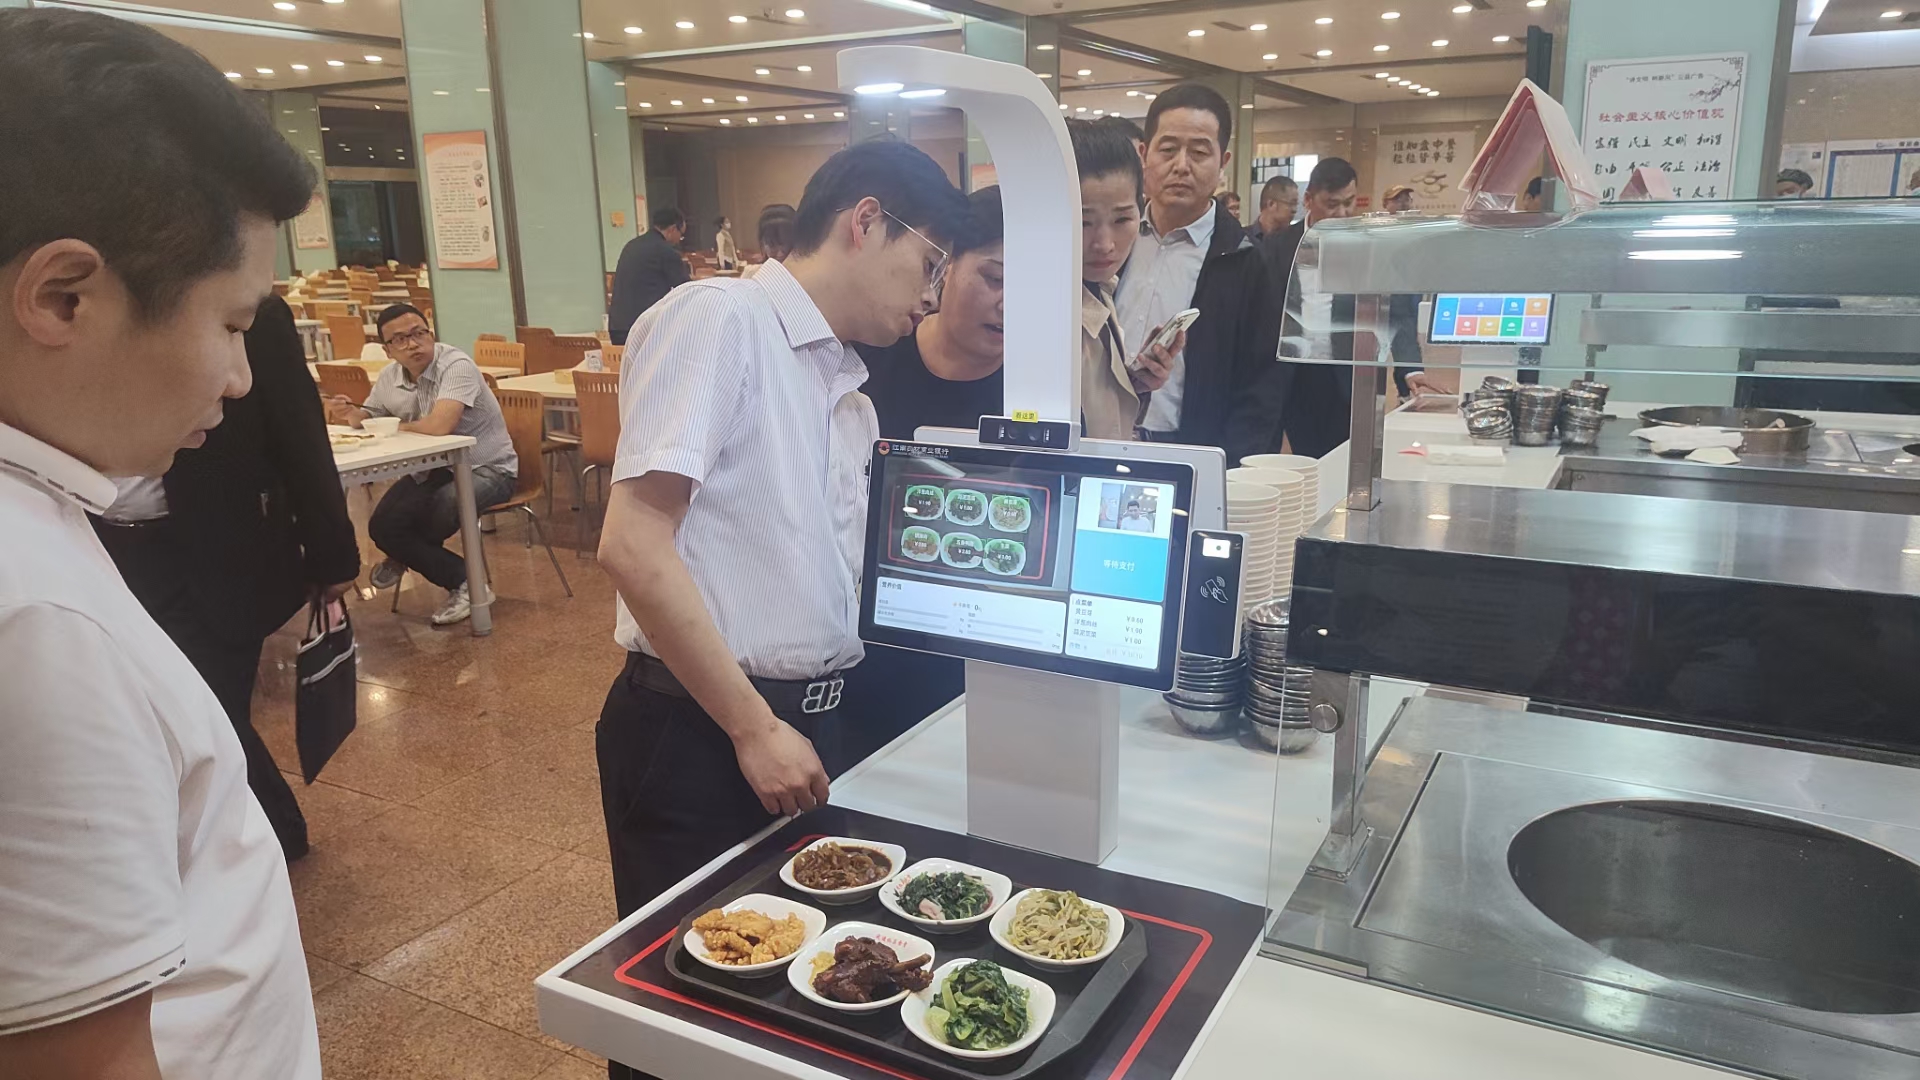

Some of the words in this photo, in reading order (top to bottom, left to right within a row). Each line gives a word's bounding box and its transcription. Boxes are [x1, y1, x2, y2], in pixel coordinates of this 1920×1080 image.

[1598, 107, 1725, 123] 社会主义核心价值观
[1628, 135, 1651, 148] 民主
[1662, 133, 1687, 147] 文明
[1696, 132, 1722, 146] 和谐
[1595, 163, 1617, 175] 自由
[1660, 160, 1685, 173] 公正
[1694, 160, 1721, 173] 法治
[1691, 185, 1718, 199] 友善
[1103, 559, 1135, 572] 等待支付
